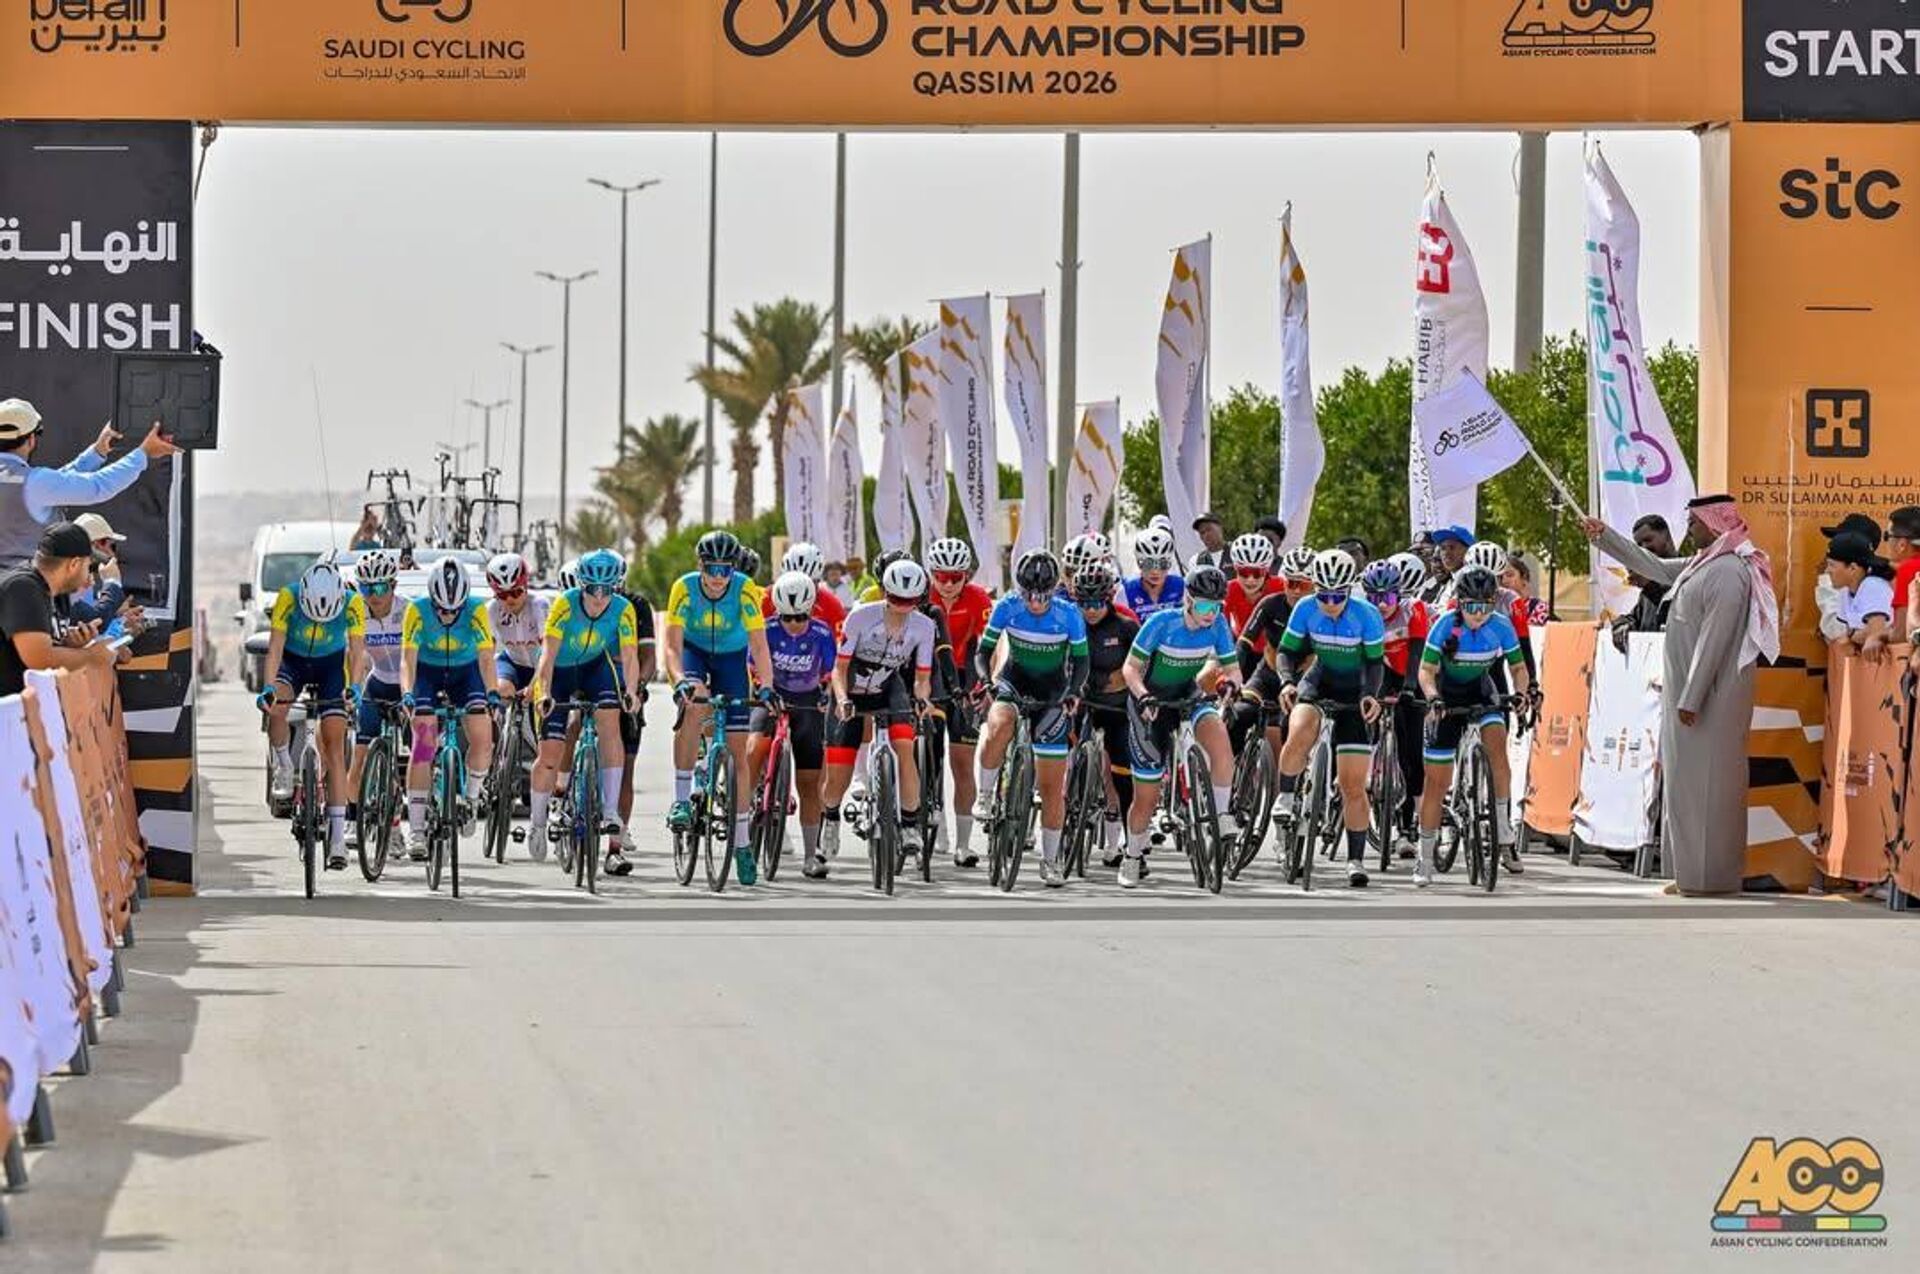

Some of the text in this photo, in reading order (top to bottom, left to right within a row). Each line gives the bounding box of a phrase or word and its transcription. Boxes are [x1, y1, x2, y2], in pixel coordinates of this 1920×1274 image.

[31, 24, 166, 52] بيرين
[324, 39, 525, 60] SAUDI CYCLING
[912, 26, 1306, 56] CHAMPIONSHIP
[1502, 47, 1656, 57] ASIAN CYCLING CONFEDERATION
[912, 71, 1118, 96] QASSIM 2026
[1779, 157, 1901, 220] stc
[1742, 491, 1766, 505] DR
[1770, 491, 1853, 505] SULAIMAN
[1858, 492, 1878, 505] AL
